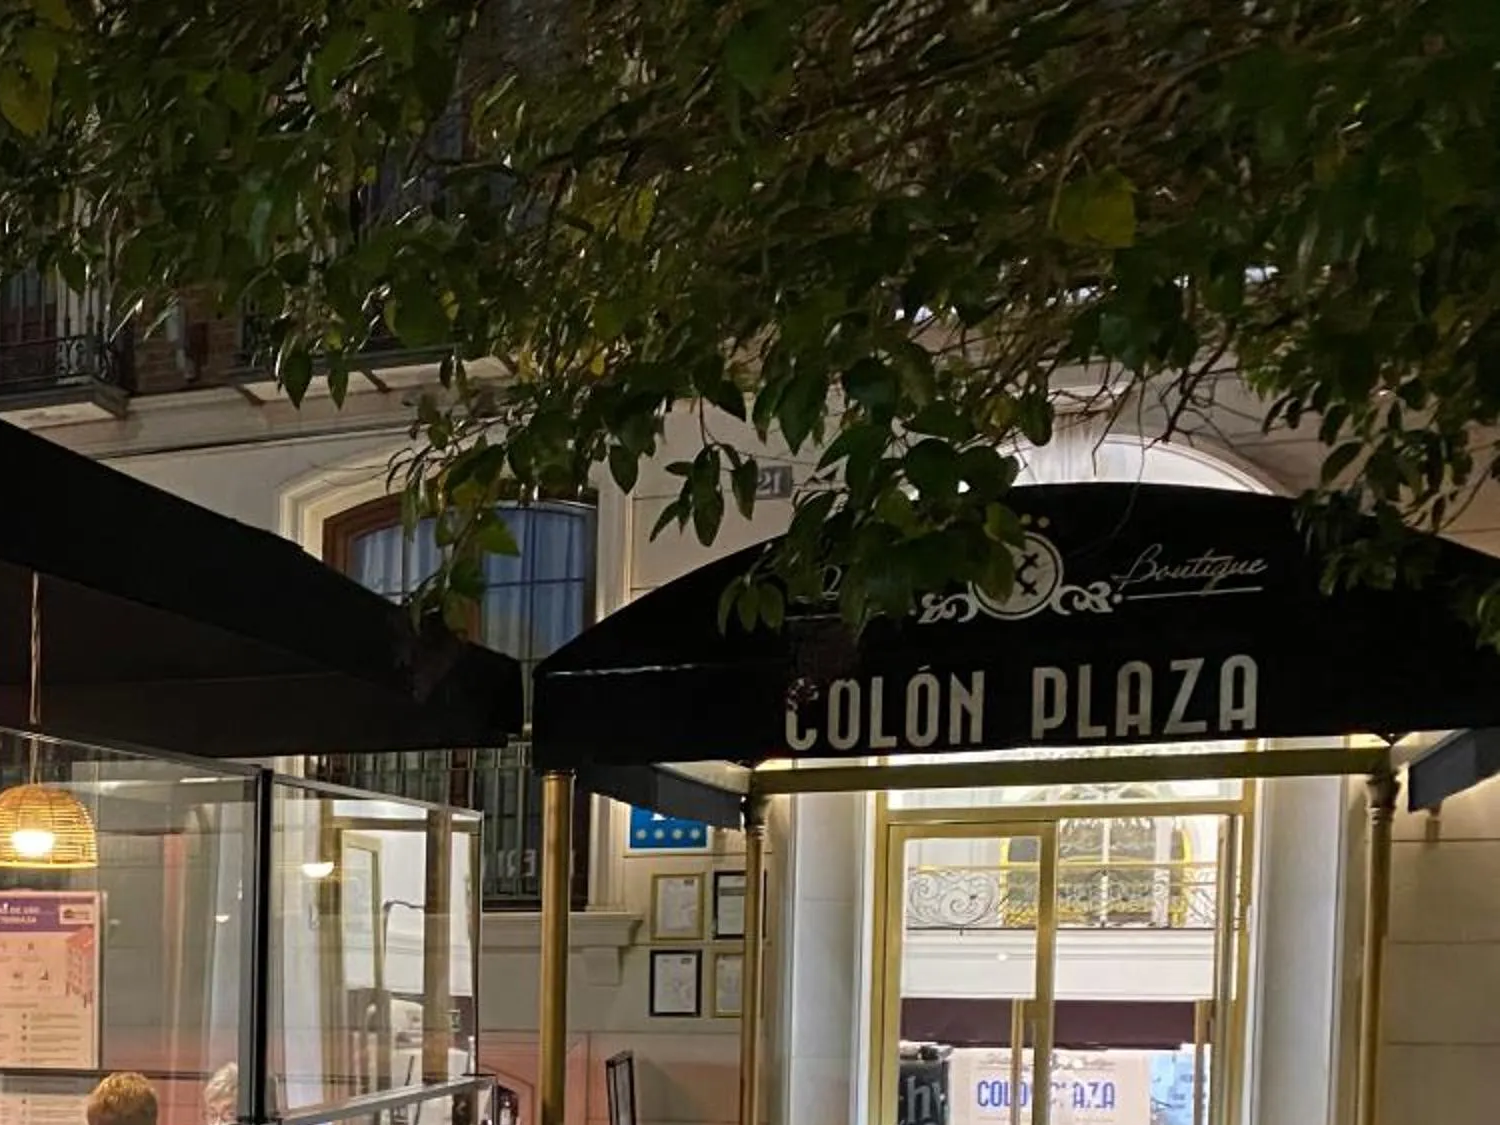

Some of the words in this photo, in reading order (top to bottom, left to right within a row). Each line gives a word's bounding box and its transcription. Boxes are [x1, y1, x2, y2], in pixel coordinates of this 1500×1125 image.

[756, 471, 783, 495] 21
[1110, 543, 1268, 597] Boutique
[785, 664, 985, 751] COLÓN
[1032, 654, 1259, 740] PLAZA
